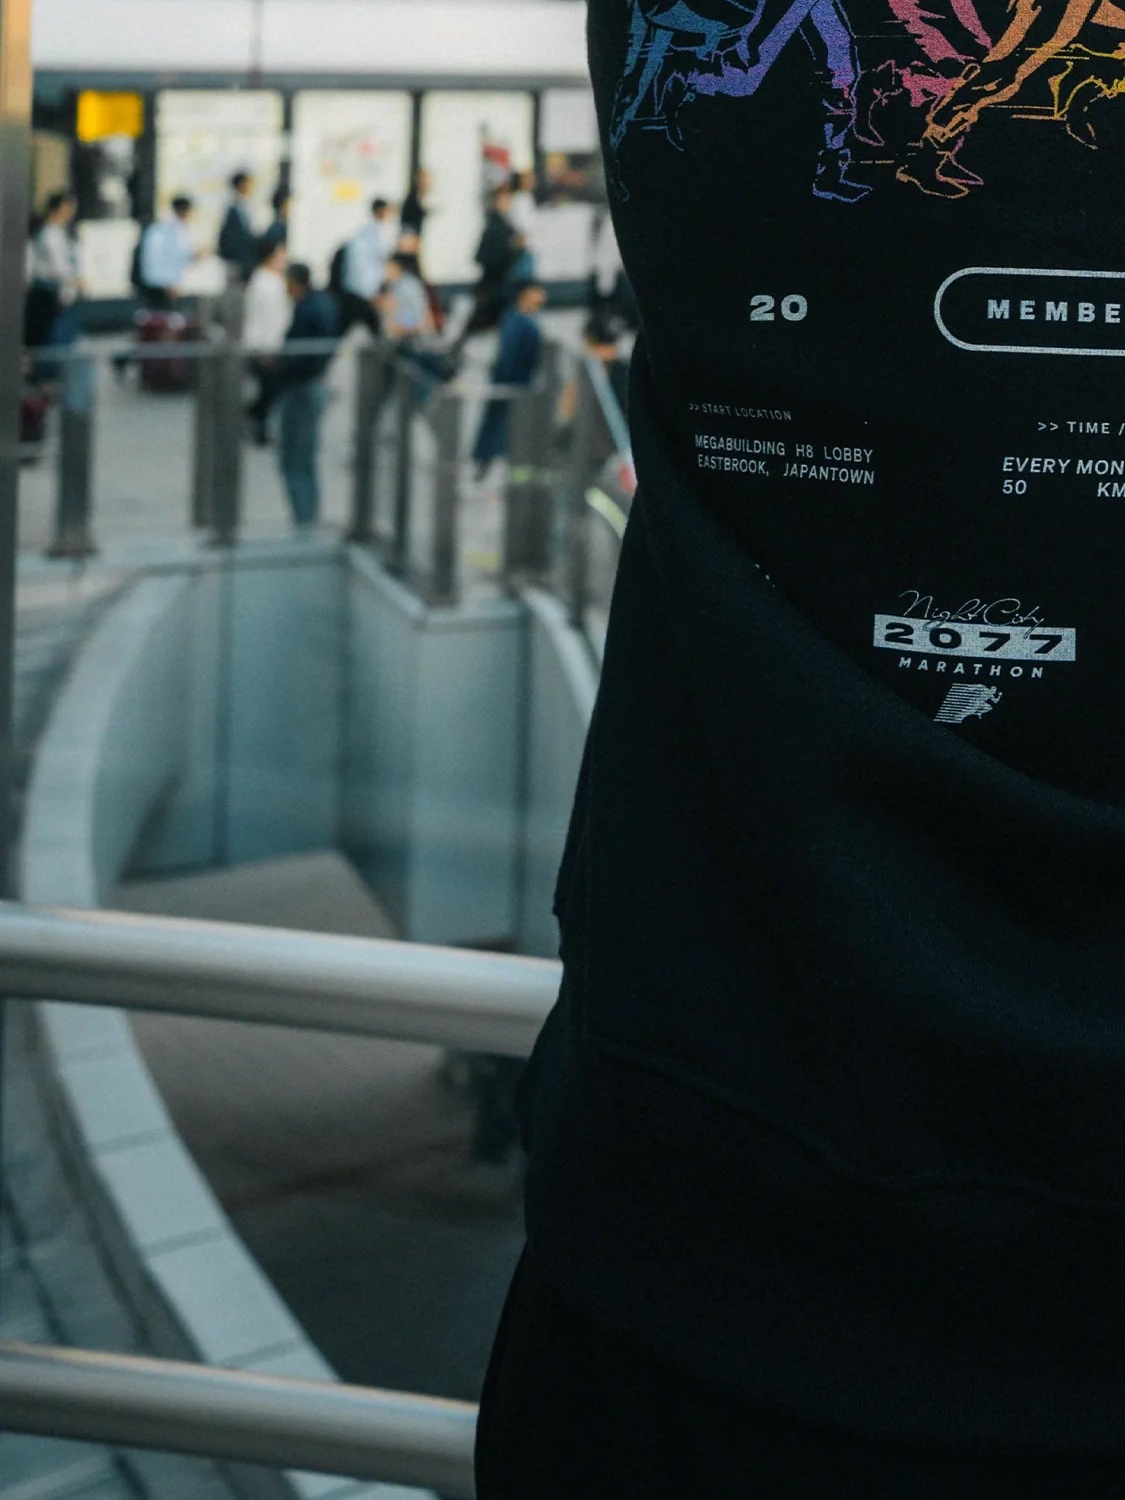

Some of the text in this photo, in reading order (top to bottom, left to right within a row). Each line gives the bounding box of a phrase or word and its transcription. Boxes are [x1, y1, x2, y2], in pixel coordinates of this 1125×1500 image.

[749, 294, 809, 322] 20
[1066, 421, 1111, 435] TIME
[694, 434, 873, 464] MEGABUILDING H8 LOBBY
[697, 453, 875, 485] EASTBROOK, JAPANTOWN
[1002, 456, 1071, 474] EVERY
[1002, 479, 1027, 495] 50
[884, 621, 1063, 655] 2077
[899, 656, 1044, 679] MARATHON
